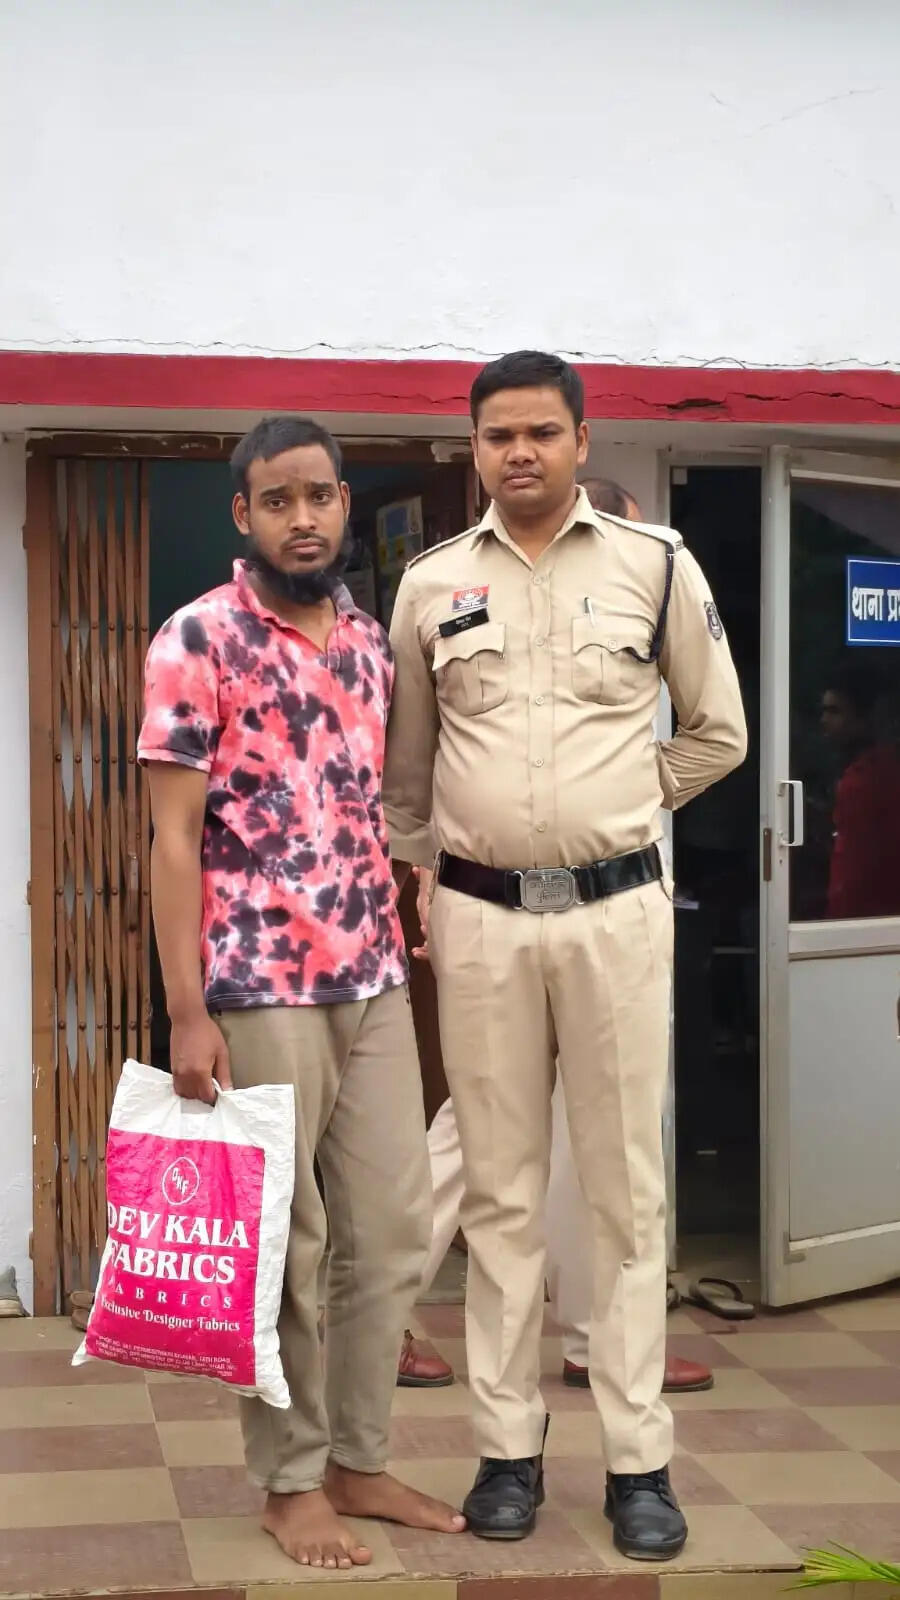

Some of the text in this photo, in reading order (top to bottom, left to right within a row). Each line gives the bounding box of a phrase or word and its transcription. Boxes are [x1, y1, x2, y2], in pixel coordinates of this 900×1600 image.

[851, 586, 900, 622] थाना प्र
[163, 1214, 251, 1249] KALA
[142, 1309, 194, 1328] Designer
[196, 1316, 241, 1332] Fabrics
